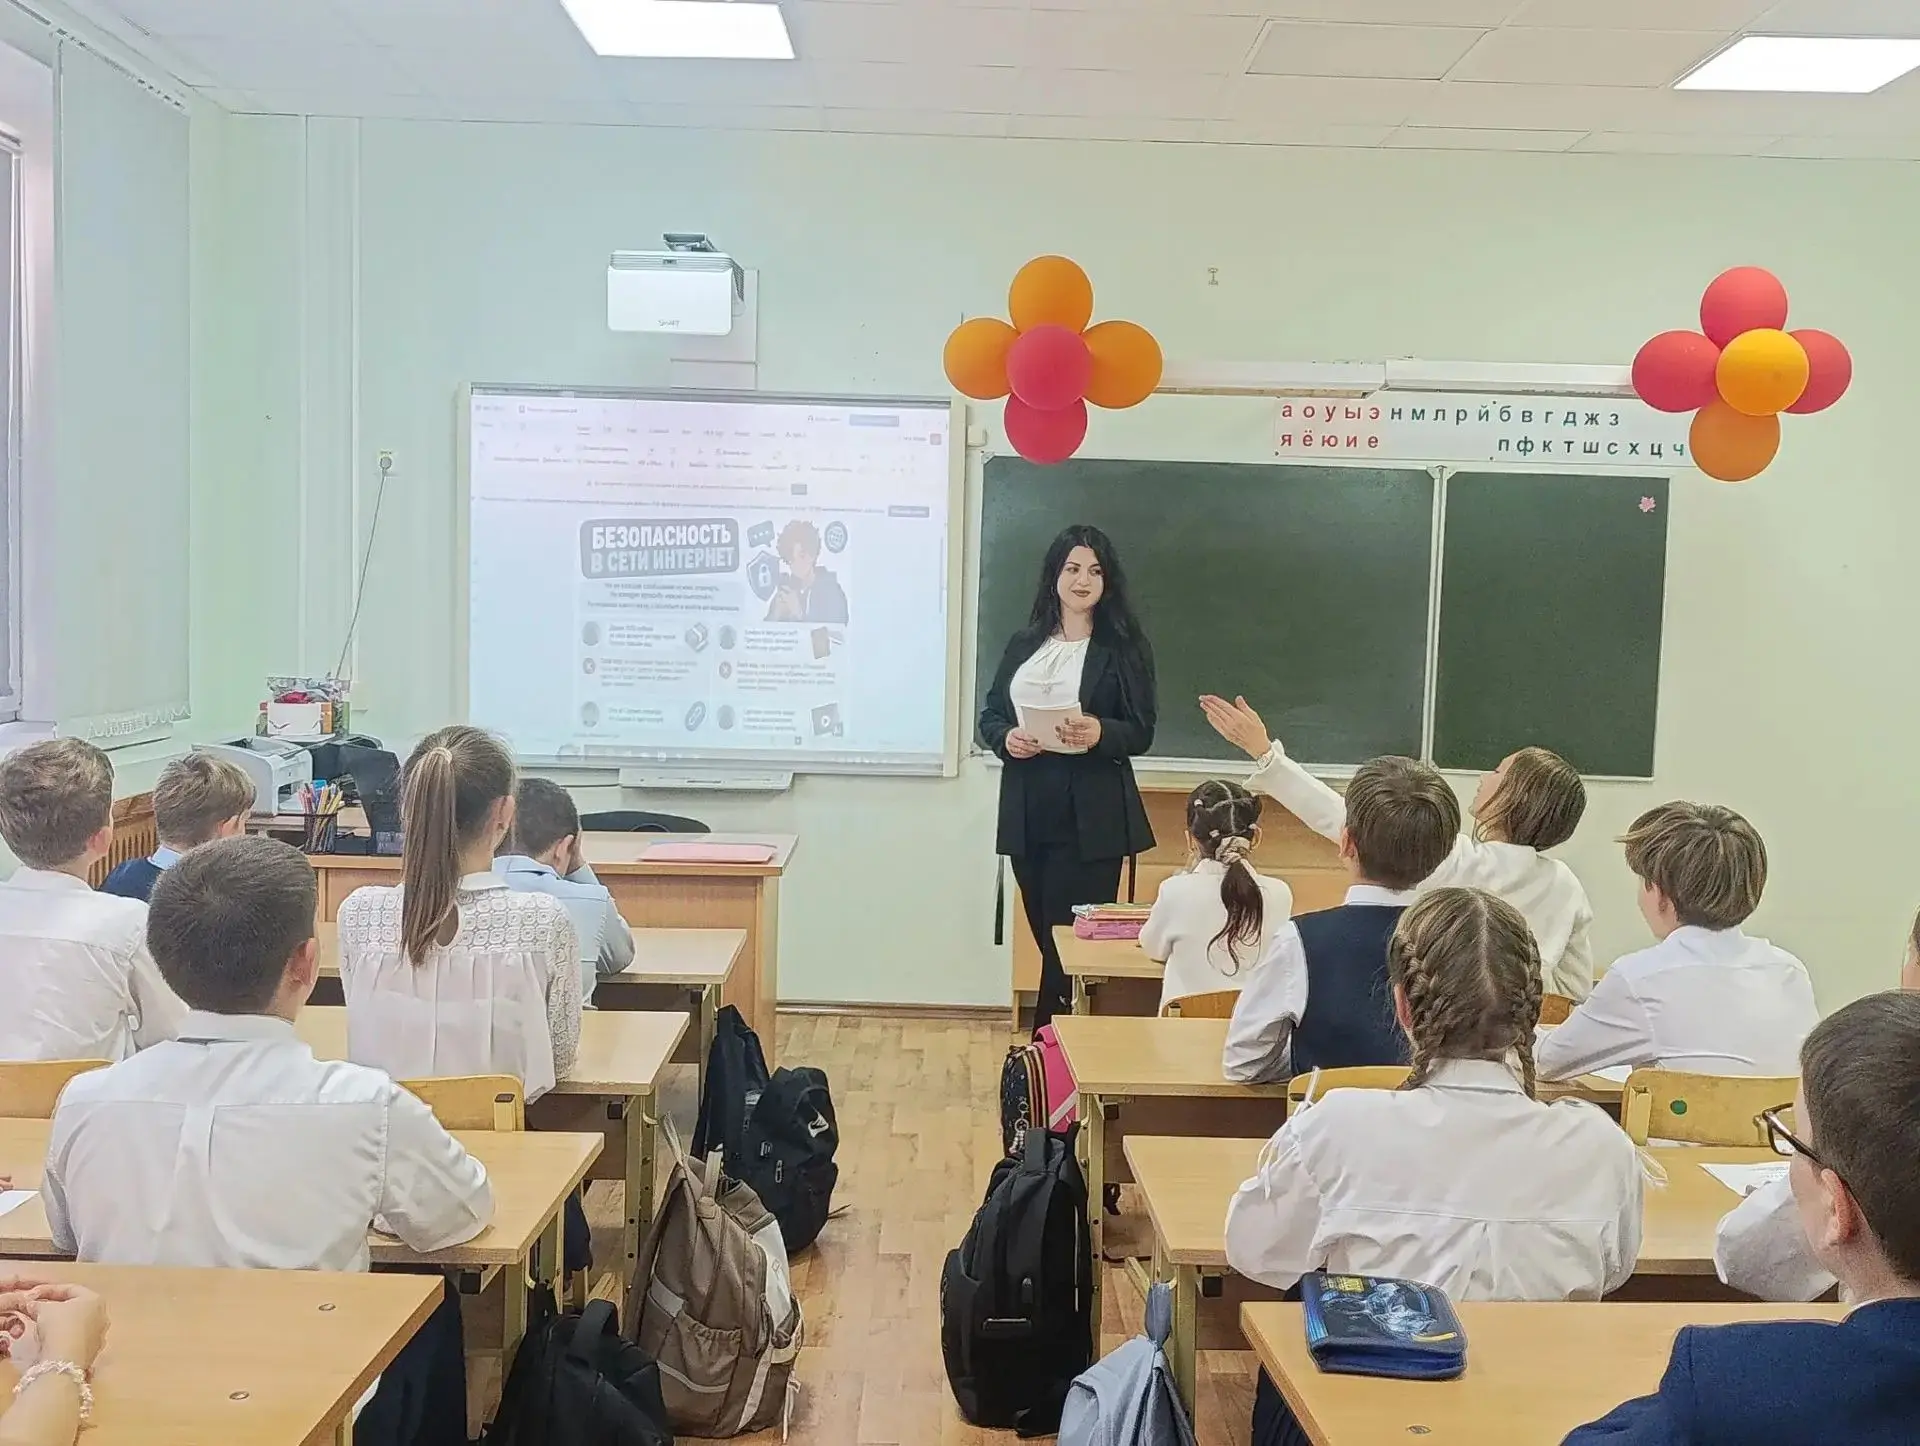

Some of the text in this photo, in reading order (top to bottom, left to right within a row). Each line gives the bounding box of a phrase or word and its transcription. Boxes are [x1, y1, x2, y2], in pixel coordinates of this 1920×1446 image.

[592, 525, 732, 549] БЕЗОПАСНОСТЬ
[591, 547, 735, 573] В СЕТИ ИНТЕРНЕТ
